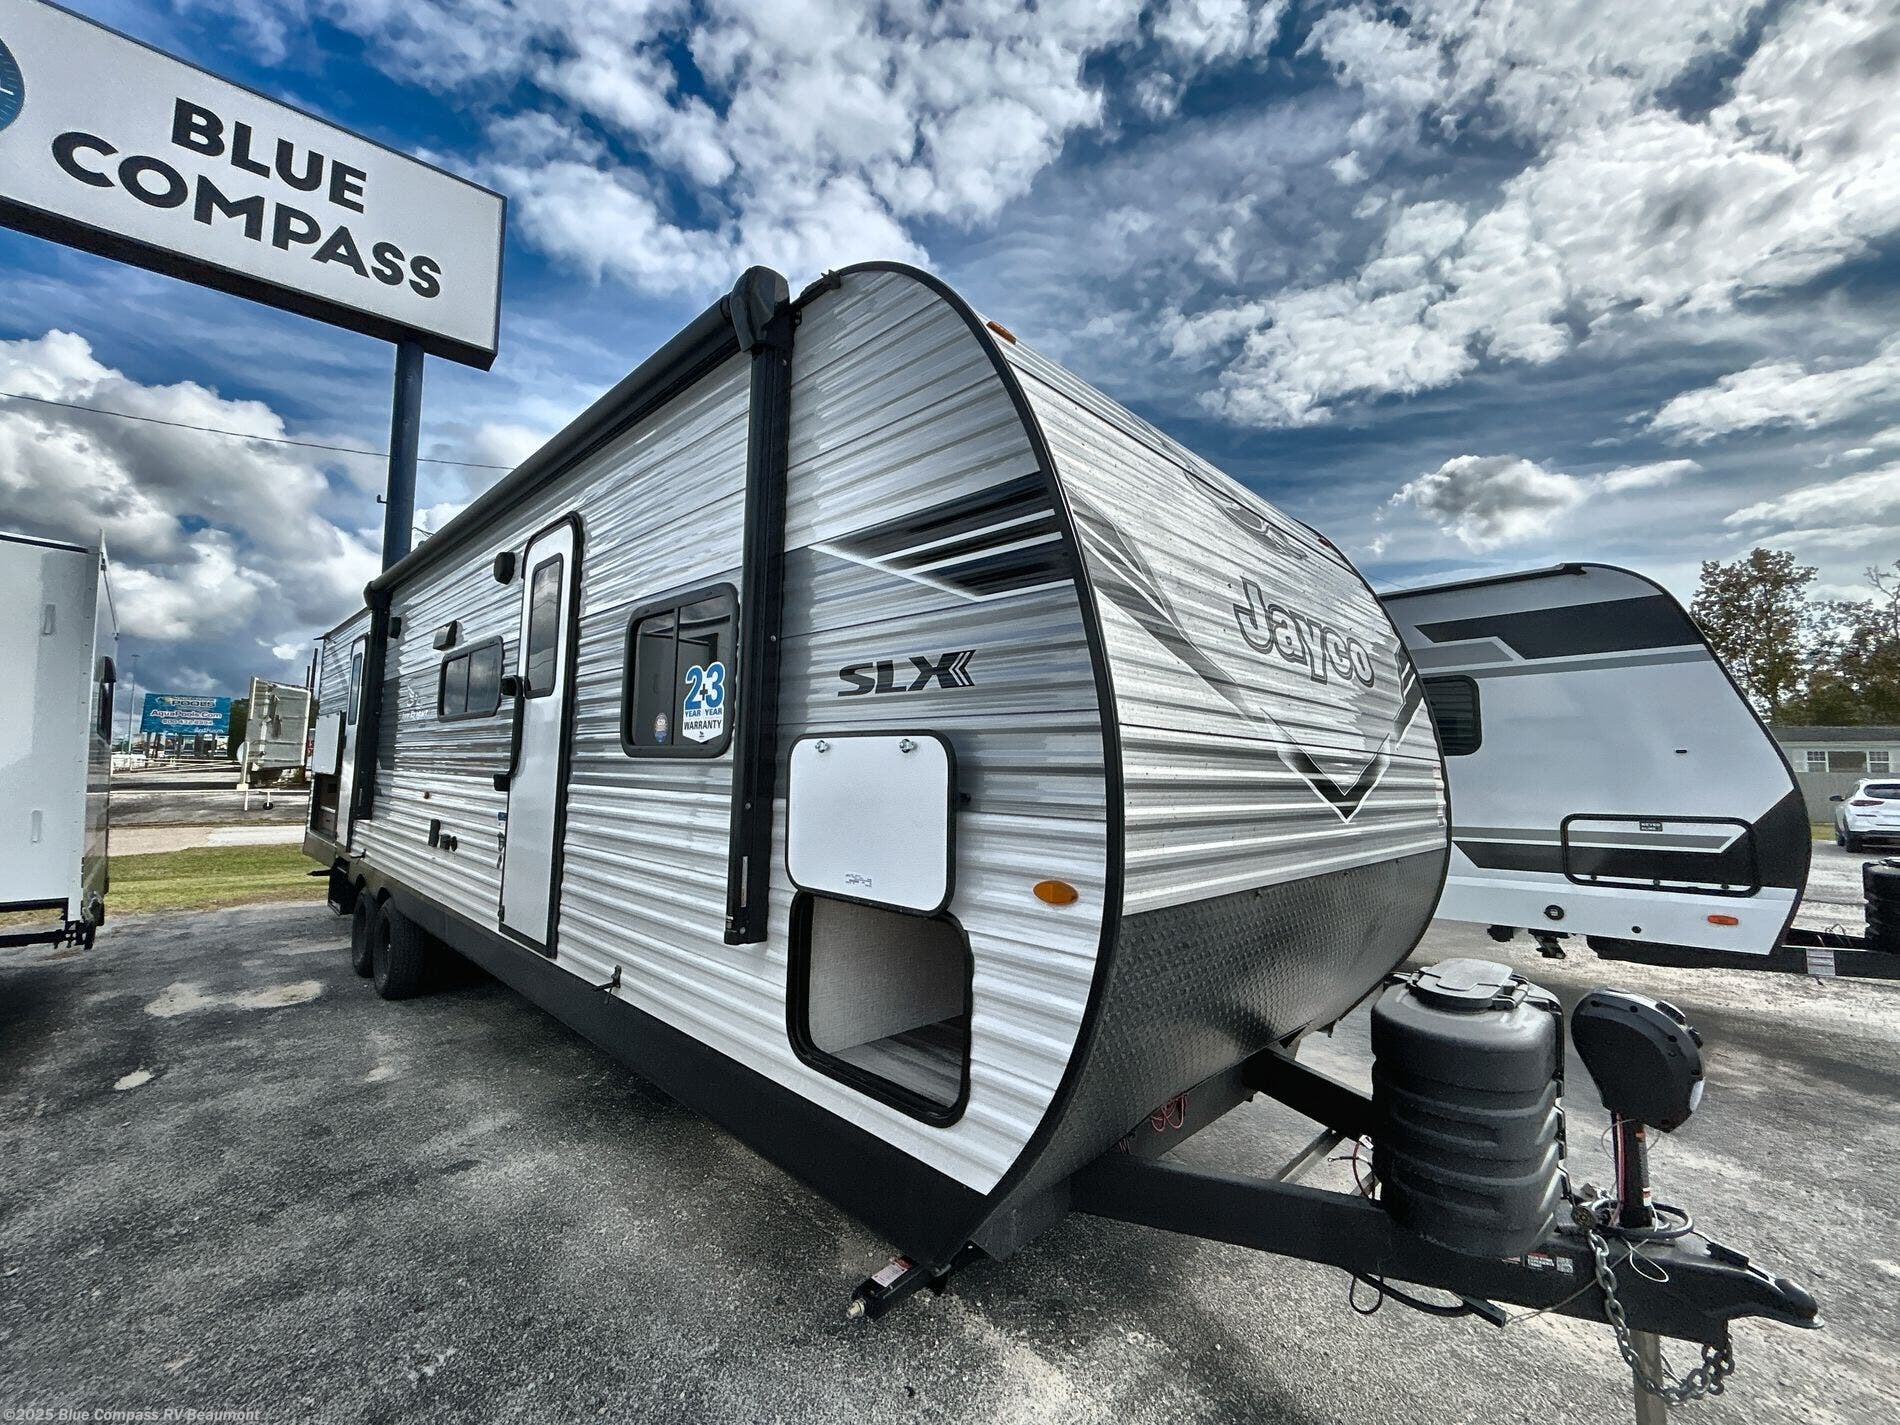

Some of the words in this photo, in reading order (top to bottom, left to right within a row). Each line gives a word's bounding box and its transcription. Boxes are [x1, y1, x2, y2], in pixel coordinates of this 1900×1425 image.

[171, 97, 367, 214] BLUE
[52, 131, 441, 298] COMPASS
[1233, 576, 1374, 688] Jayco
[705, 708, 722, 716] YEAR
[838, 650, 976, 697] SLX
[684, 720, 721, 730] WARRANTY
